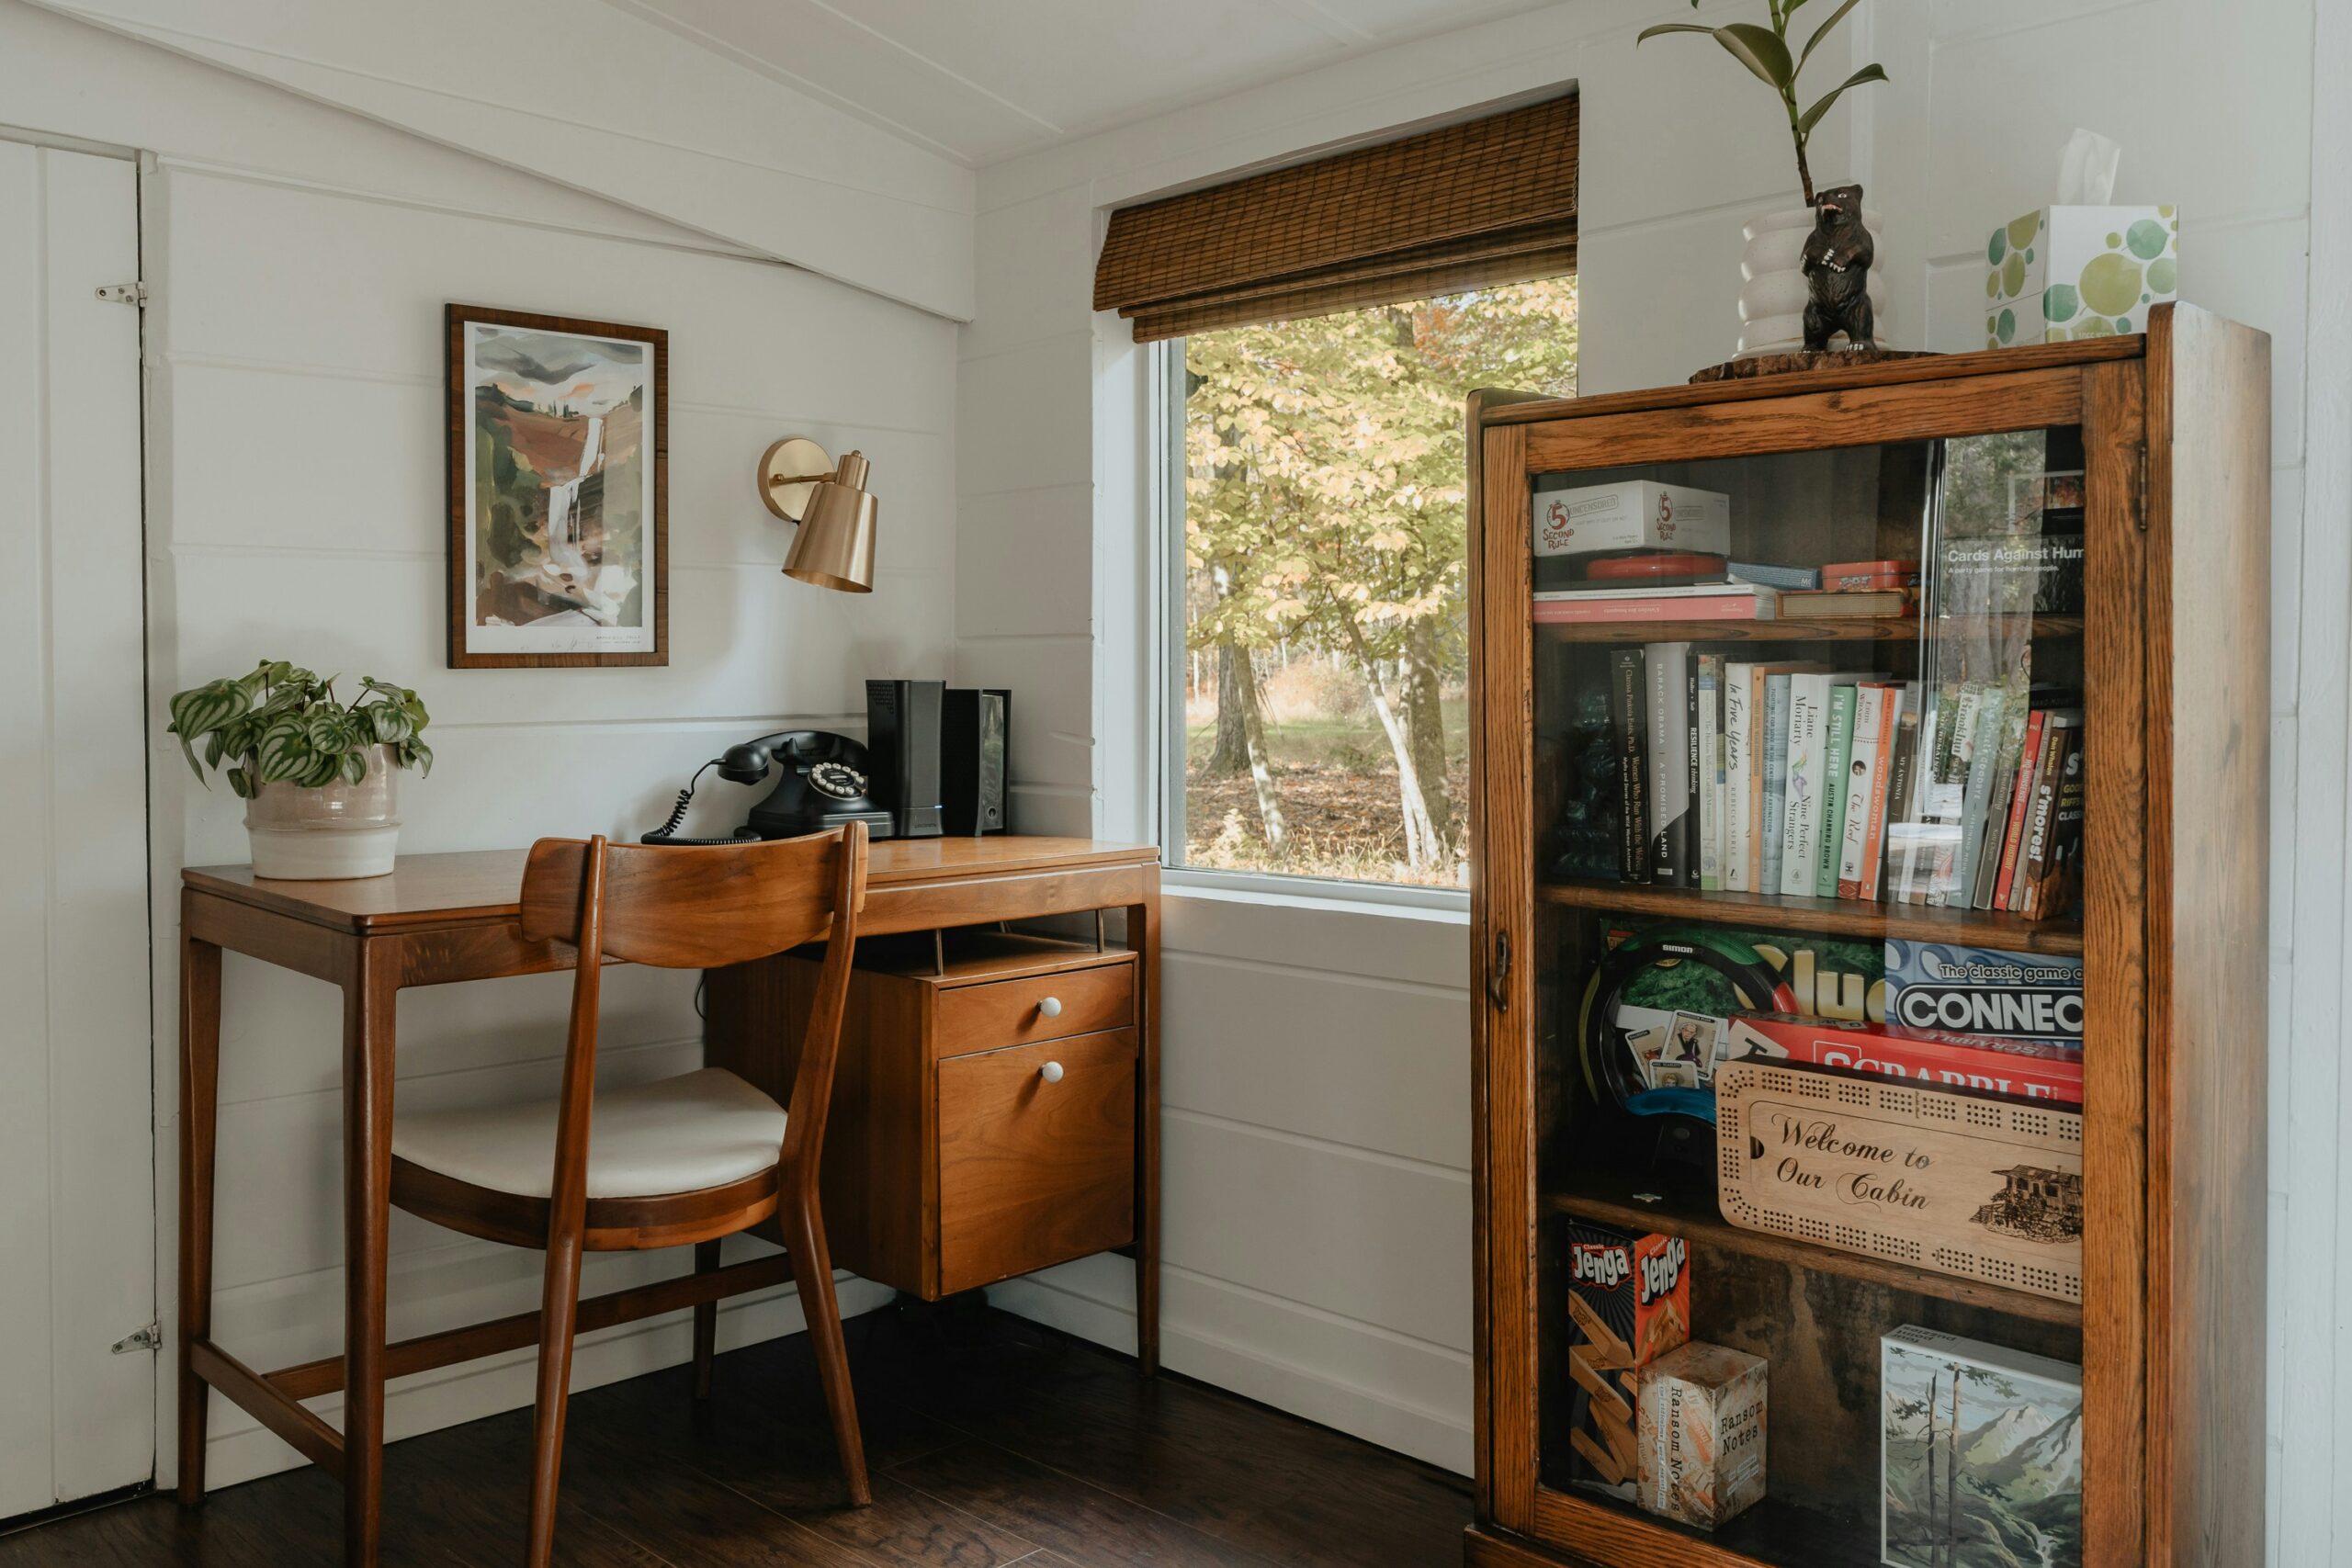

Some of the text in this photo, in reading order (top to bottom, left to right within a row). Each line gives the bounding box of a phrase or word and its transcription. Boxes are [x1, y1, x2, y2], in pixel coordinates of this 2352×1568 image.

[1551, 502, 1566, 530] 5
[1570, 498, 1617, 515] UNCENSORED
[1657, 518, 1676, 532] SECOND
[1661, 497, 1671, 522] 5
[1543, 528, 1575, 541] SECOND
[1548, 538, 1570, 550] RULE
[1660, 530, 1674, 541] RULE
[1948, 549, 1990, 562] Cards
[1994, 547, 2048, 563] Against
[1956, 566, 1973, 575] party
[1974, 566, 1992, 575] game
[2034, 565, 2059, 574] people.
[1625, 670, 1634, 693] Clarissa
[1626, 694, 1634, 716] Pinkola
[1657, 663, 1666, 745] BARACK OBAMA
[1790, 695, 1807, 747] Moriarty
[1806, 706, 1818, 739] Liane
[1863, 702, 1872, 724] EDITH
[1725, 683, 1743, 771] In Five Years
[1828, 694, 1845, 778] I'M STILL HERE
[1952, 696, 1973, 755] Brooklyn
[1627, 737, 1636, 754] Ph.D.
[1900, 756, 1906, 766] MY
[2045, 737, 2058, 776] Dan Whalen
[1659, 773, 1668, 827] PROMISED
[1690, 768, 1699, 795] thinking
[1870, 756, 1885, 840] woodswoman
[1994, 773, 2010, 811] Awakening
[2017, 759, 2033, 803] NO-NONSENSE
[1632, 756, 1644, 871] Women Who Run With the Wolves
[1786, 801, 1800, 851] Strangers
[1798, 795, 1812, 860] Nine Perfect
[1823, 784, 1836, 870] AUSTIN CHANNING BROWN
[1846, 794, 1864, 845] The Reef
[2029, 784, 2052, 862] s'mores!
[2004, 821, 2021, 871] WORLD HISTORY
[1940, 964, 1967, 979] The
[1969, 964, 2022, 980] classic
[2024, 967, 2070, 983] game
[1924, 1031, 2040, 1055] SCRABBLE
[1771, 1113, 1934, 1169] Welcome to
[1777, 1156, 1929, 1213] Our Cabin
[1650, 1236, 1668, 1256] Classic
[1573, 1246, 1630, 1286] Jenga
[1641, 1236, 1686, 1303] Jenga
[1720, 1400, 1764, 1436] Ransom
[1670, 1386, 1683, 1512] Ransom Notes
[1723, 1424, 1758, 1457] Notes
